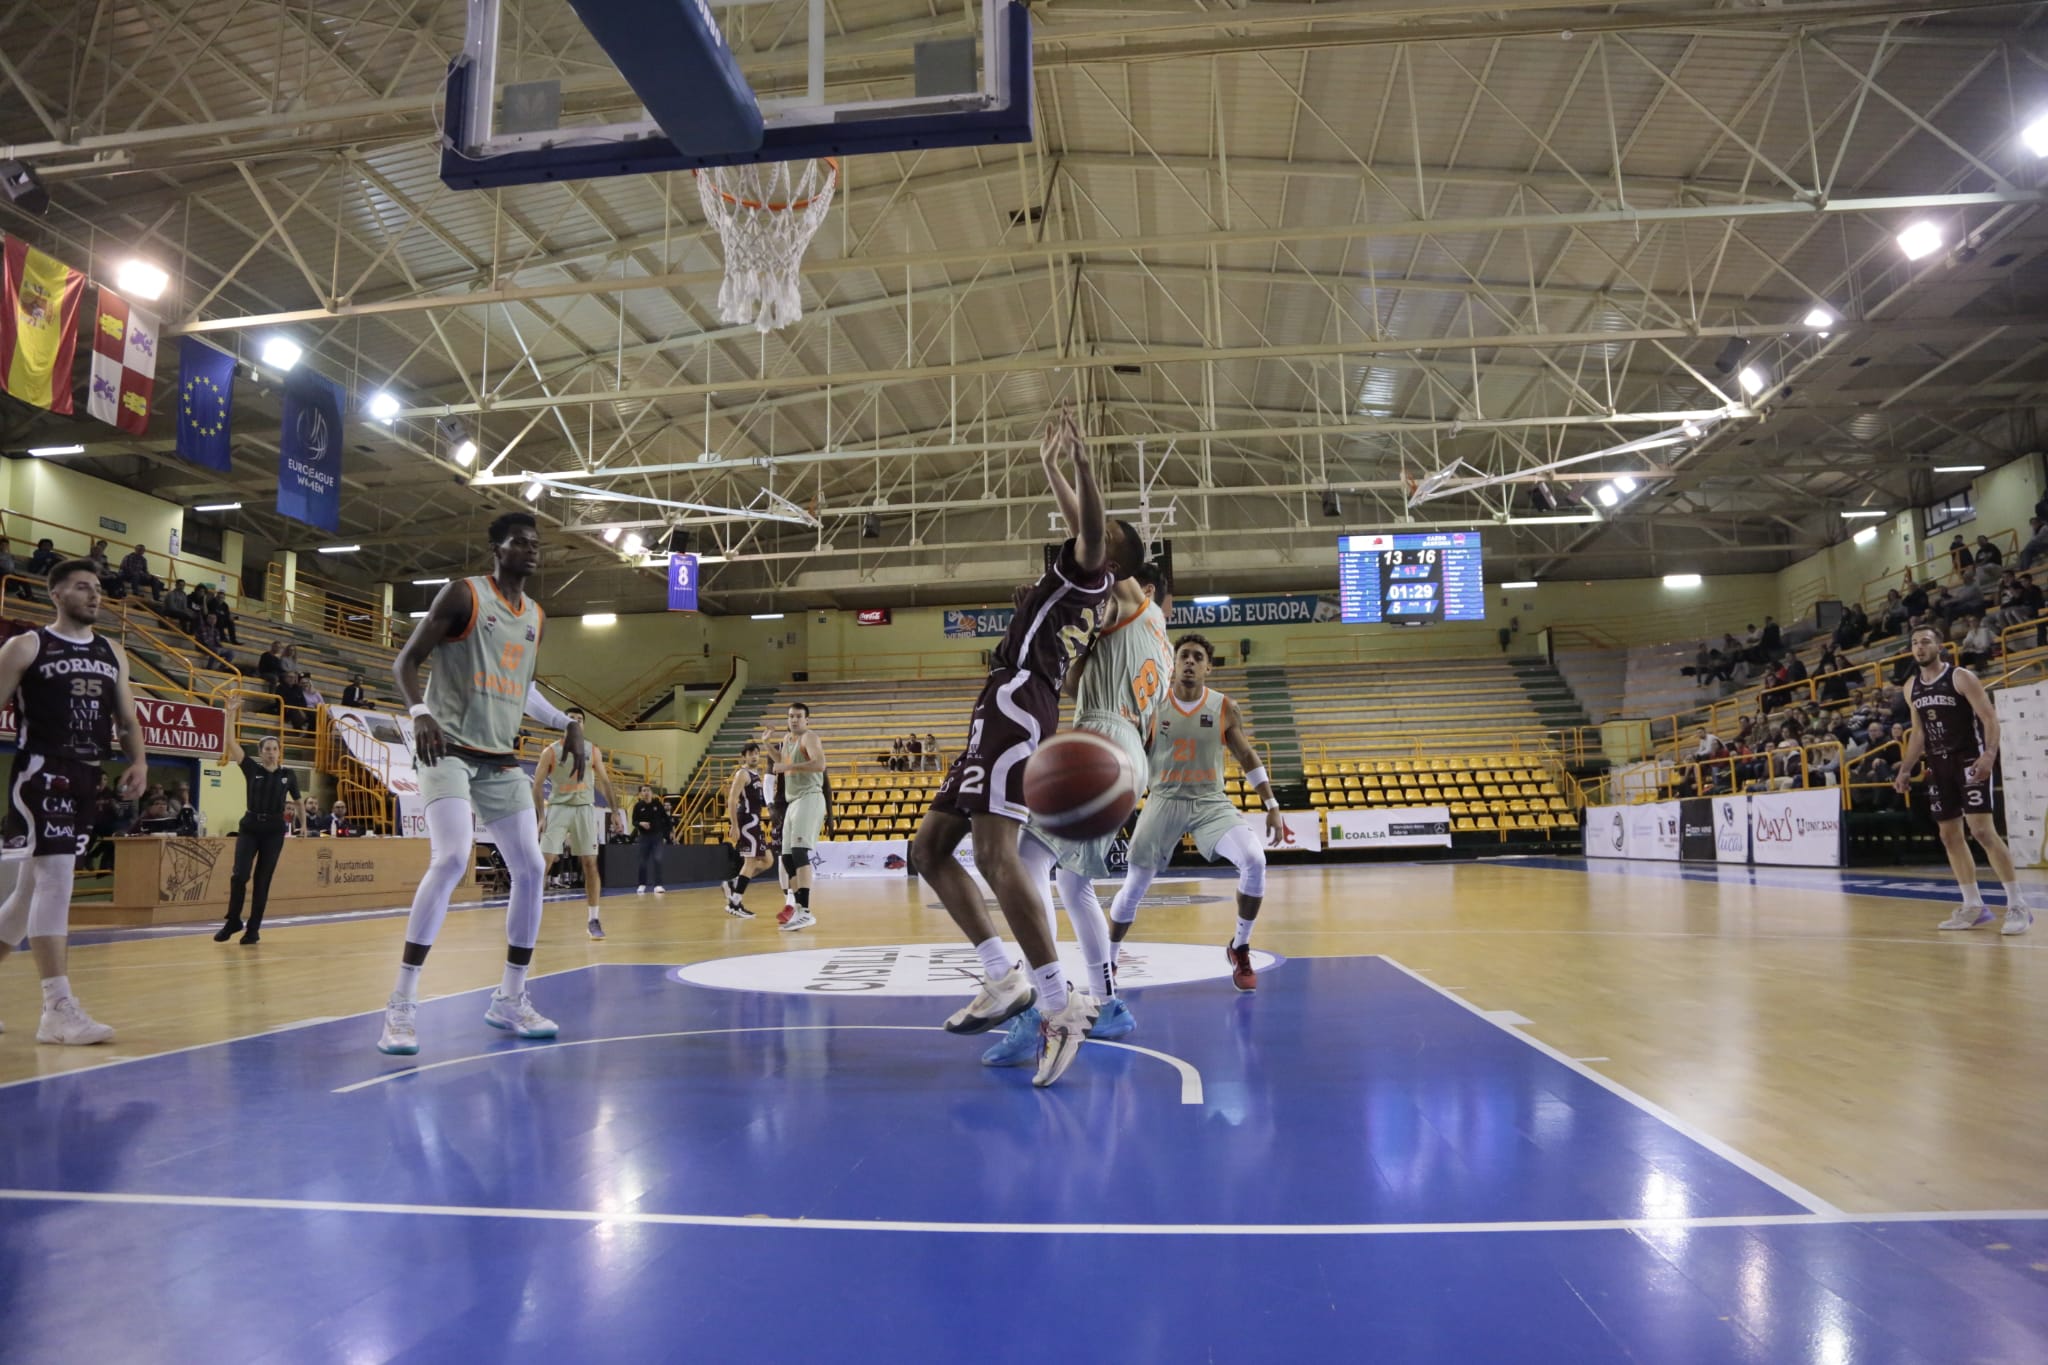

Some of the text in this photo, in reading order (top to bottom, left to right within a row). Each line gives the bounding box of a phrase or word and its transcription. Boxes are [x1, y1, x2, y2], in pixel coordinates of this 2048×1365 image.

[288, 458, 335, 487] EUROLEAGUE
[297, 474, 324, 494] WOMEN
[1384, 550, 1436, 565] 13 16
[678, 565, 689, 586] 8
[1389, 584, 1433, 599] 01:29
[1166, 604, 1216, 625] EINAS
[1220, 604, 1242, 623] DE
[1245, 600, 1311, 621] EUROPA
[1392, 602, 1402, 613] 5
[1423, 601, 1432, 612] 1
[499, 640, 525, 671] 10
[70, 678, 103, 697] 35
[1133, 658, 1159, 712] 8
[1913, 695, 1957, 709] ORMES
[1926, 709, 1937, 720] 3
[1173, 738, 1196, 761] 21
[959, 765, 985, 794] 2
[1967, 790, 1983, 806] 3
[1345, 831, 1386, 840] COALSA
[335, 860, 374, 871] Ayuntamiento
[335, 873, 374, 883] de Salamanca
